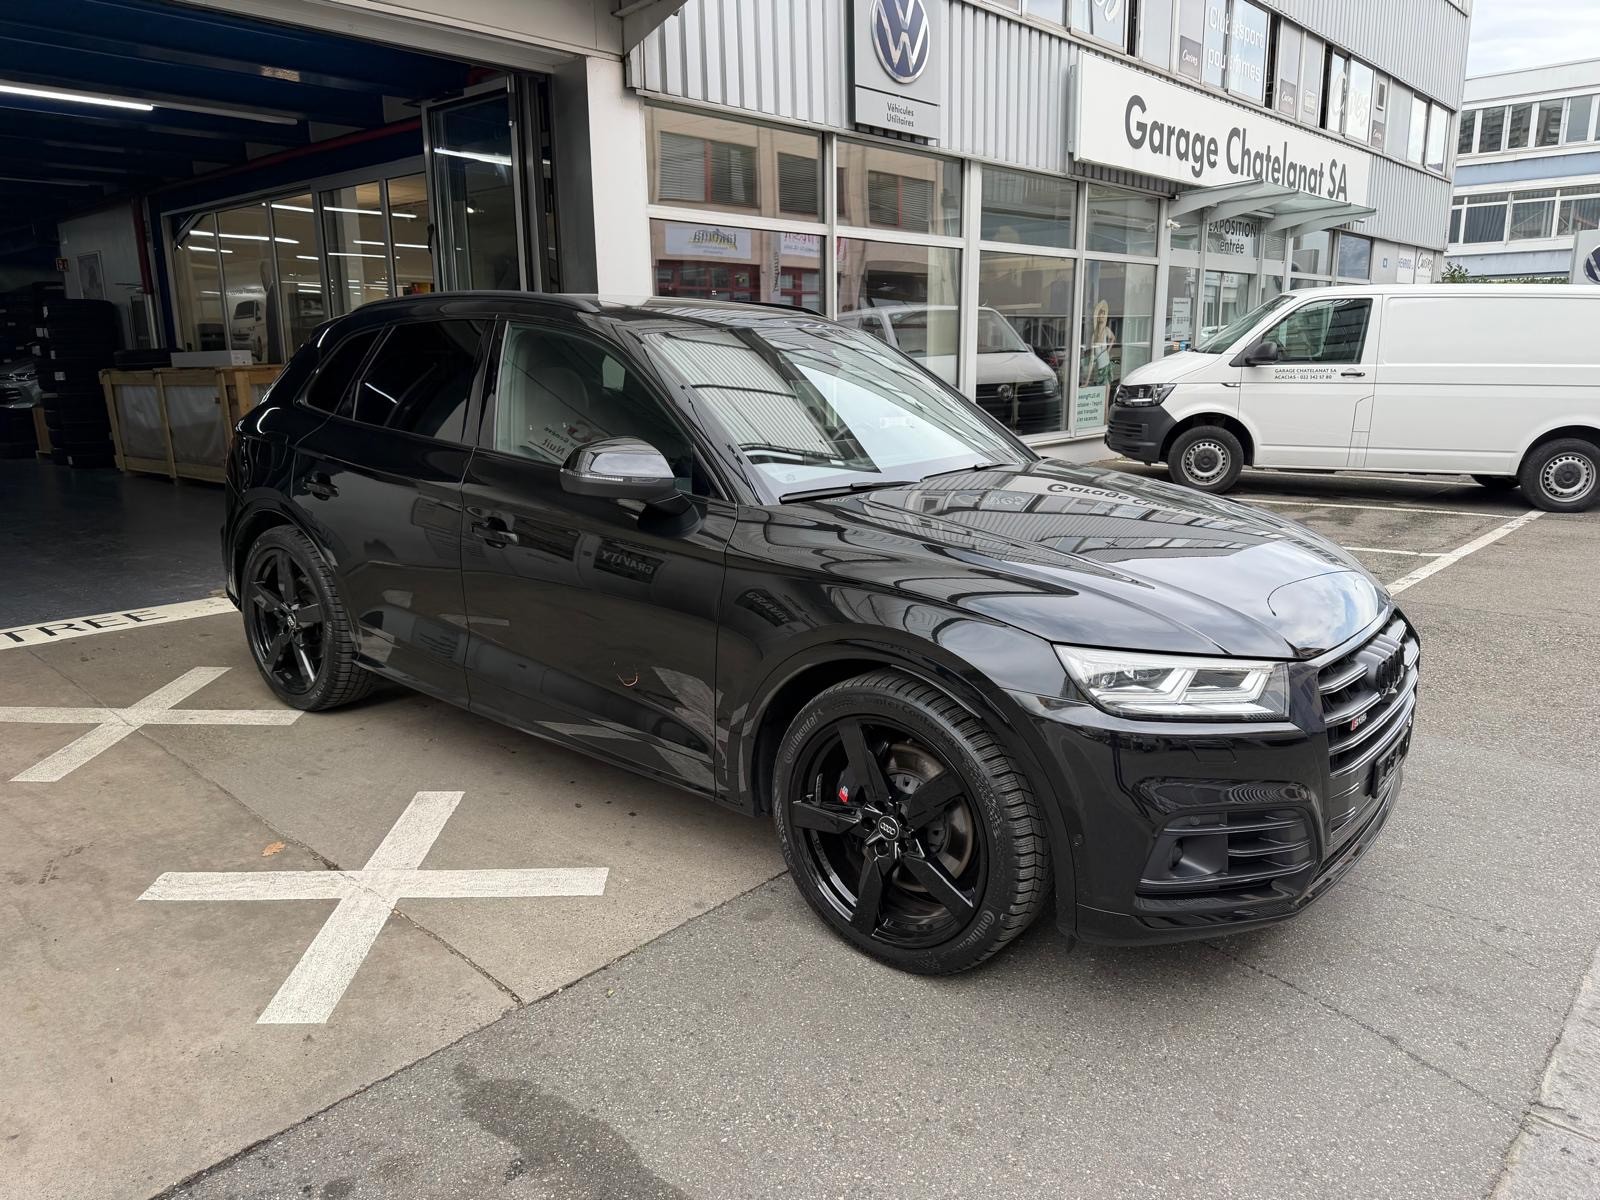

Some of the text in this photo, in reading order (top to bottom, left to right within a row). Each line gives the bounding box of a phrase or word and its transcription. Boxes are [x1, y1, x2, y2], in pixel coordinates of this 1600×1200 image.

[887, 102, 914, 117] Véhicules
[886, 113, 914, 127] Utilitaires
[1125, 94, 1348, 201] Garage Chatelanat SA
[1208, 219, 1257, 237] EXPOSITION
[1220, 238, 1245, 254] entrée
[785, 712, 818, 765] Continental
